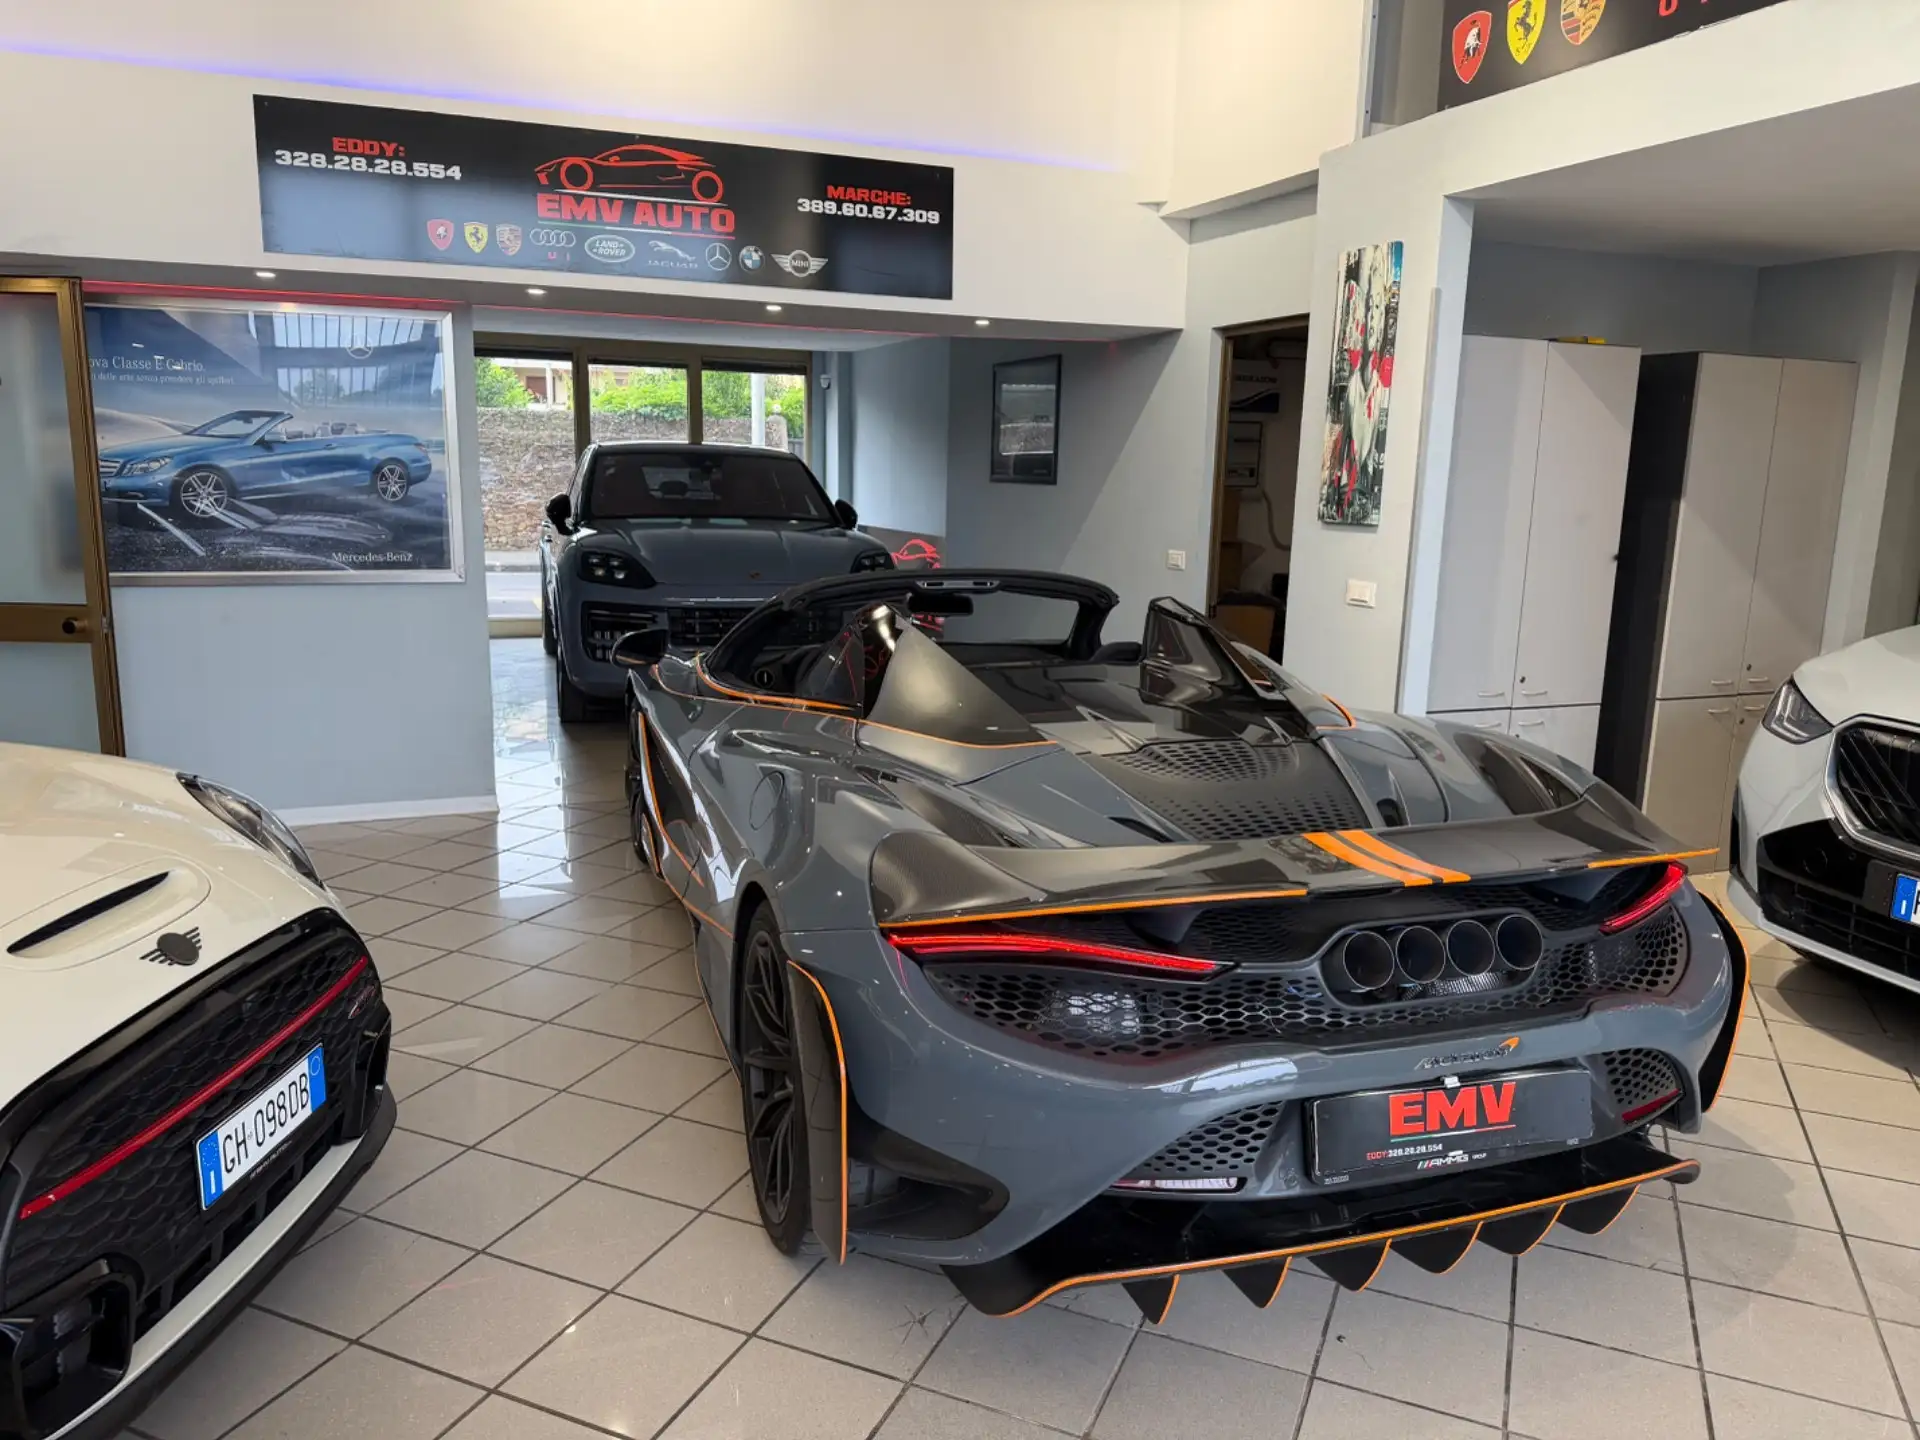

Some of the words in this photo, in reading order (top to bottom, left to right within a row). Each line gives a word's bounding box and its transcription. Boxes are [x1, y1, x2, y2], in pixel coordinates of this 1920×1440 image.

[332, 136, 405, 156] EDDY:
[275, 149, 462, 180] 328.28.28.554
[827, 185, 911, 206] MARCHE:
[537, 192, 624, 223] EMV
[633, 202, 735, 233] AUTO
[797, 198, 940, 224] 389.60.67.309
[595, 239, 618, 249] LAND
[597, 246, 626, 257] ROVER
[648, 259, 699, 270] JAGUAR
[791, 260, 809, 268] MINI
[88, 357, 109, 369] ova
[112, 355, 152, 370] Classe
[155, 357, 164, 371] E
[331, 551, 413, 563] Mercedes-Benz
[1389, 1081, 1517, 1136] EMV
